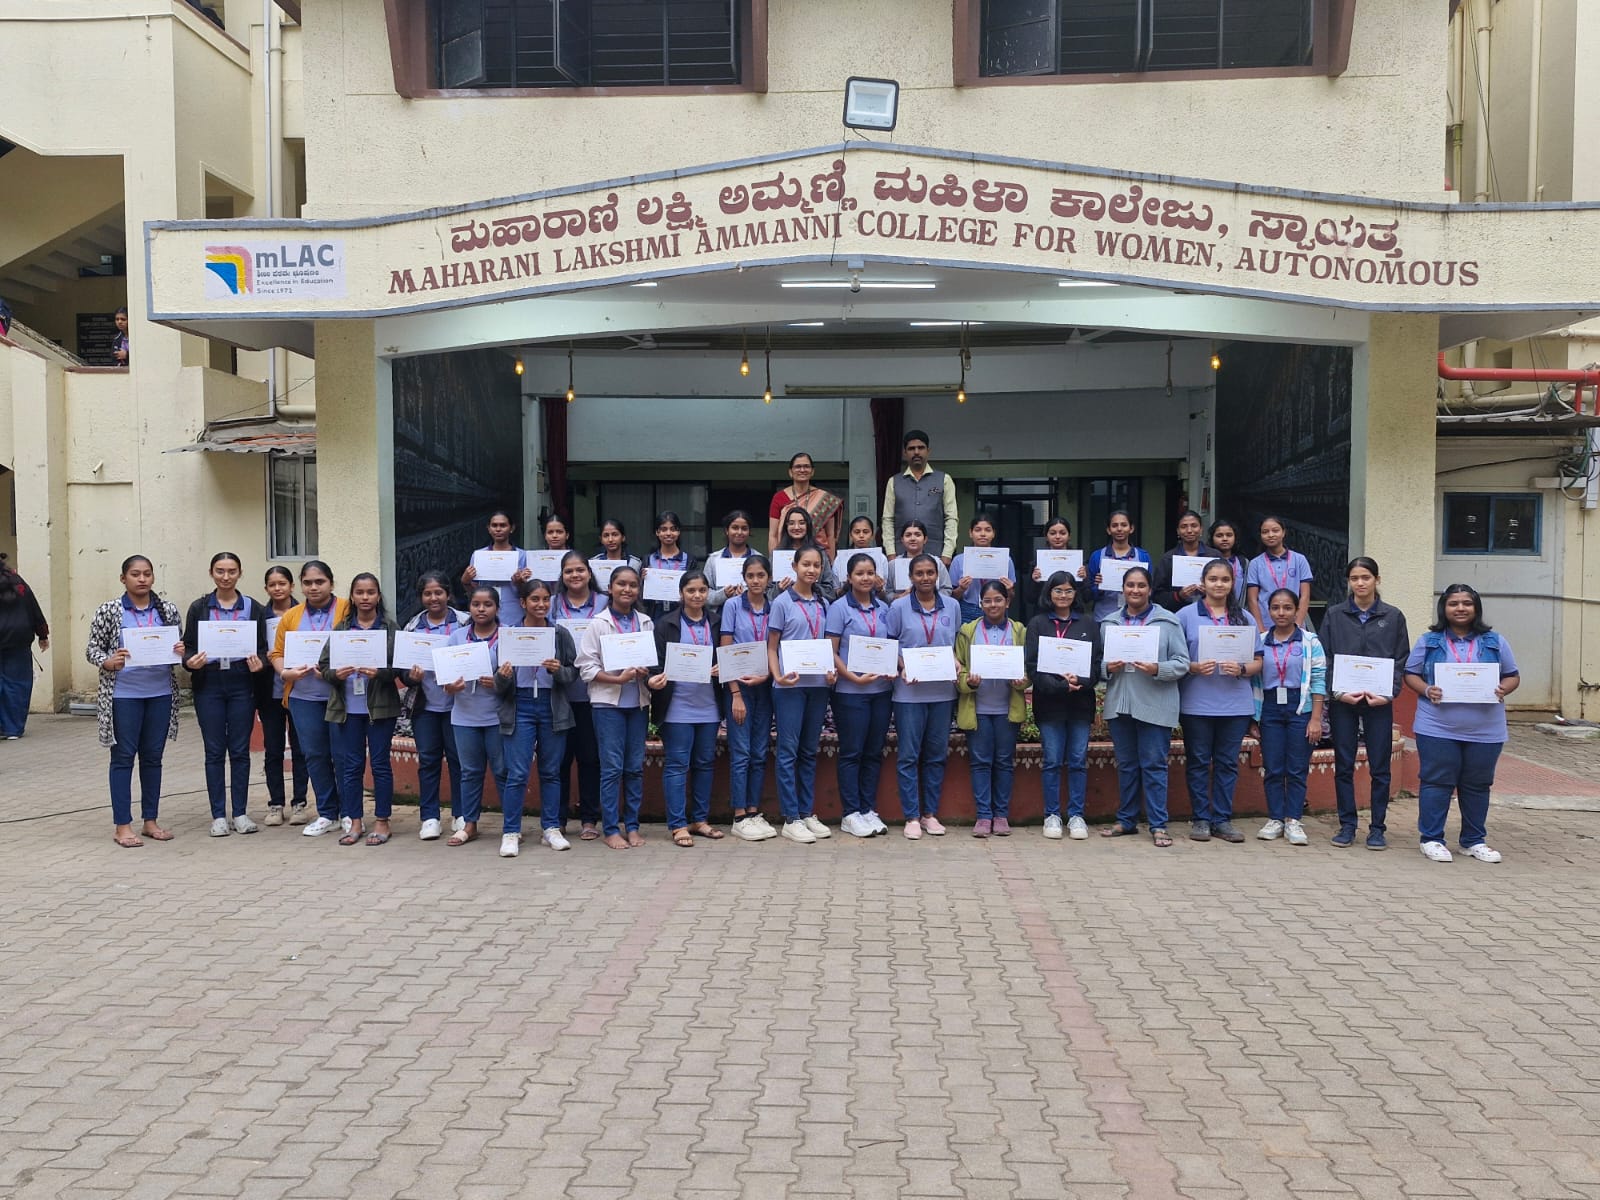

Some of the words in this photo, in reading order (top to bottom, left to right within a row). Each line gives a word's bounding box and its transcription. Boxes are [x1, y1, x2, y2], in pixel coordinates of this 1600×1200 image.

[450, 192, 619, 254] ಮಹಾರಾಣಿ
[718, 159, 858, 215] ಅಮ್ಮಣ್ಣಿ
[873, 166, 1028, 214] ಮಹಿಳಾ
[1050, 185, 1230, 240] ಕಾಲೇಜು,
[1248, 209, 1404, 259] ಸ್ವಾಯತ್ತ
[255, 244, 335, 269] mLAC
[388, 252, 542, 295] MAHARANI
[554, 233, 681, 274] LAKSHMI
[694, 212, 843, 255] AMMANNI
[856, 210, 998, 247] COLLEGE
[1012, 222, 1077, 254] FOR
[1094, 230, 1224, 273] WOMEN,
[1233, 247, 1480, 287] AUTONOMOUS
